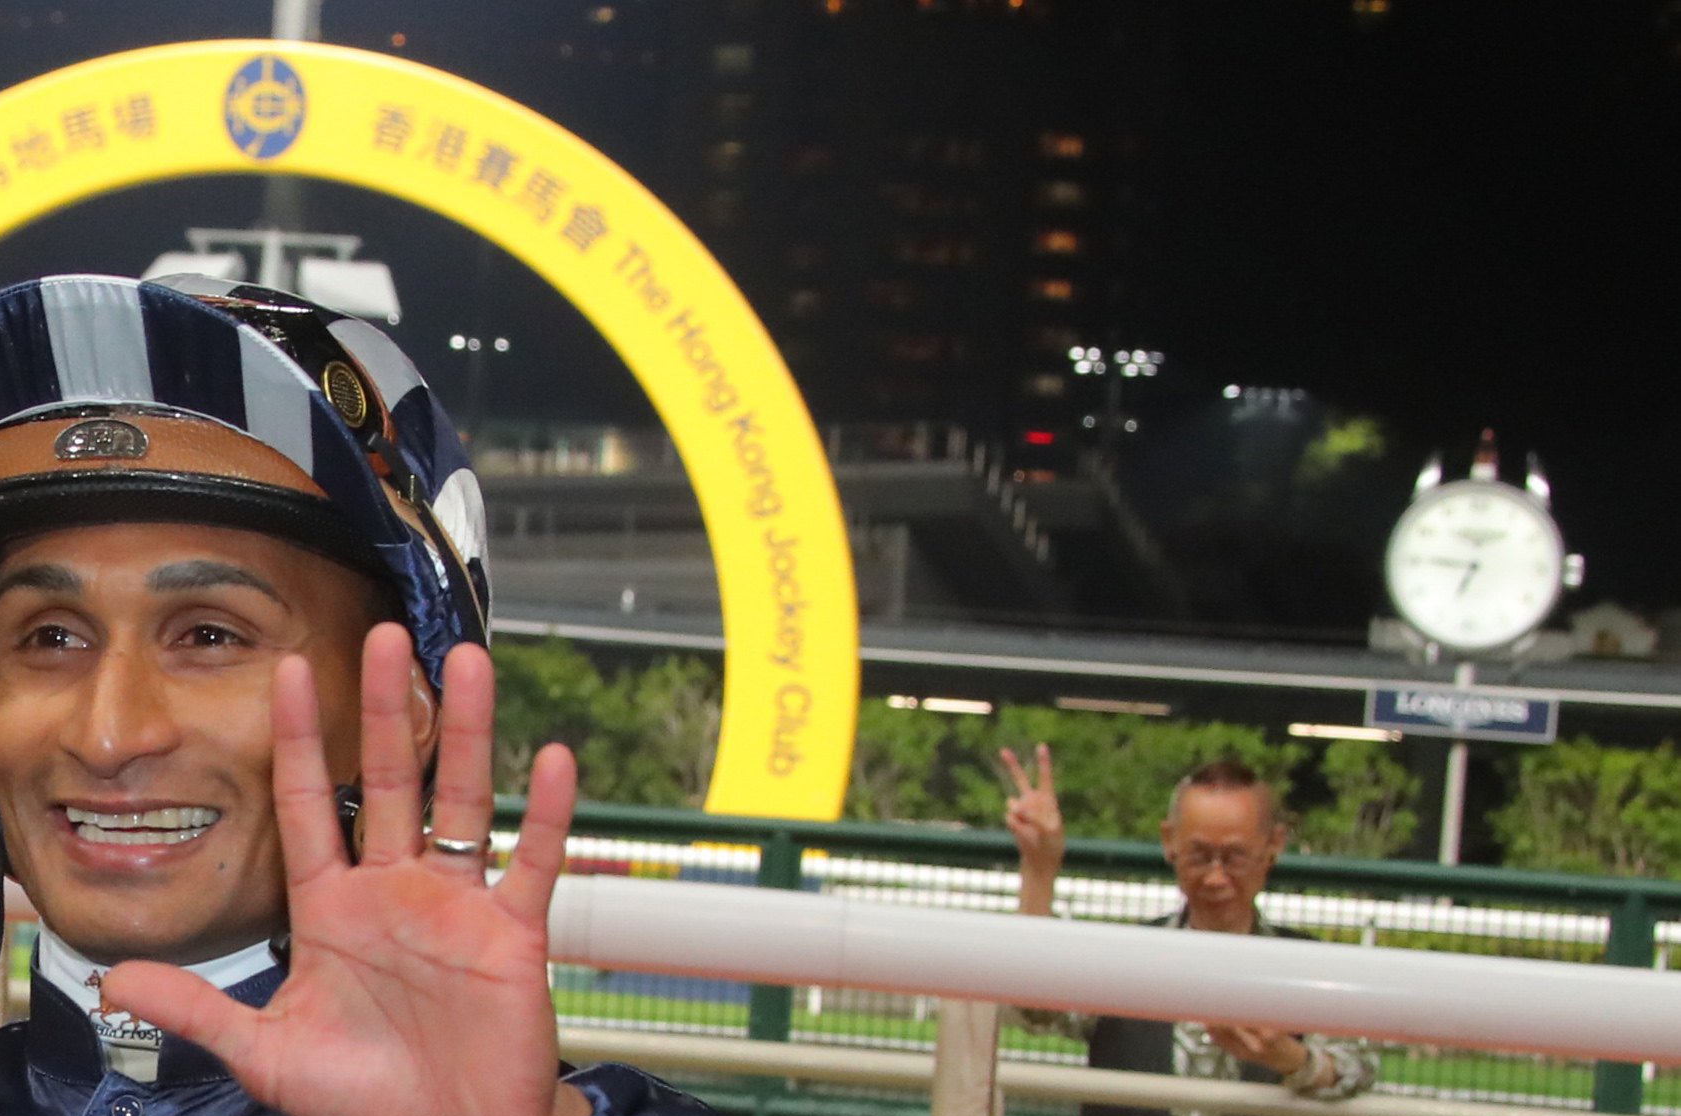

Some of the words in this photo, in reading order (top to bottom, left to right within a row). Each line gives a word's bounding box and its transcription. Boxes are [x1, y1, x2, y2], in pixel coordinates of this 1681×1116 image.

[373, 104, 608, 256] 香港賽馬會
[613, 239, 673, 315] The
[665, 307, 739, 416] Hong
[726, 410, 785, 520] Kong
[761, 526, 810, 673] Jockey
[765, 682, 815, 779] Club
